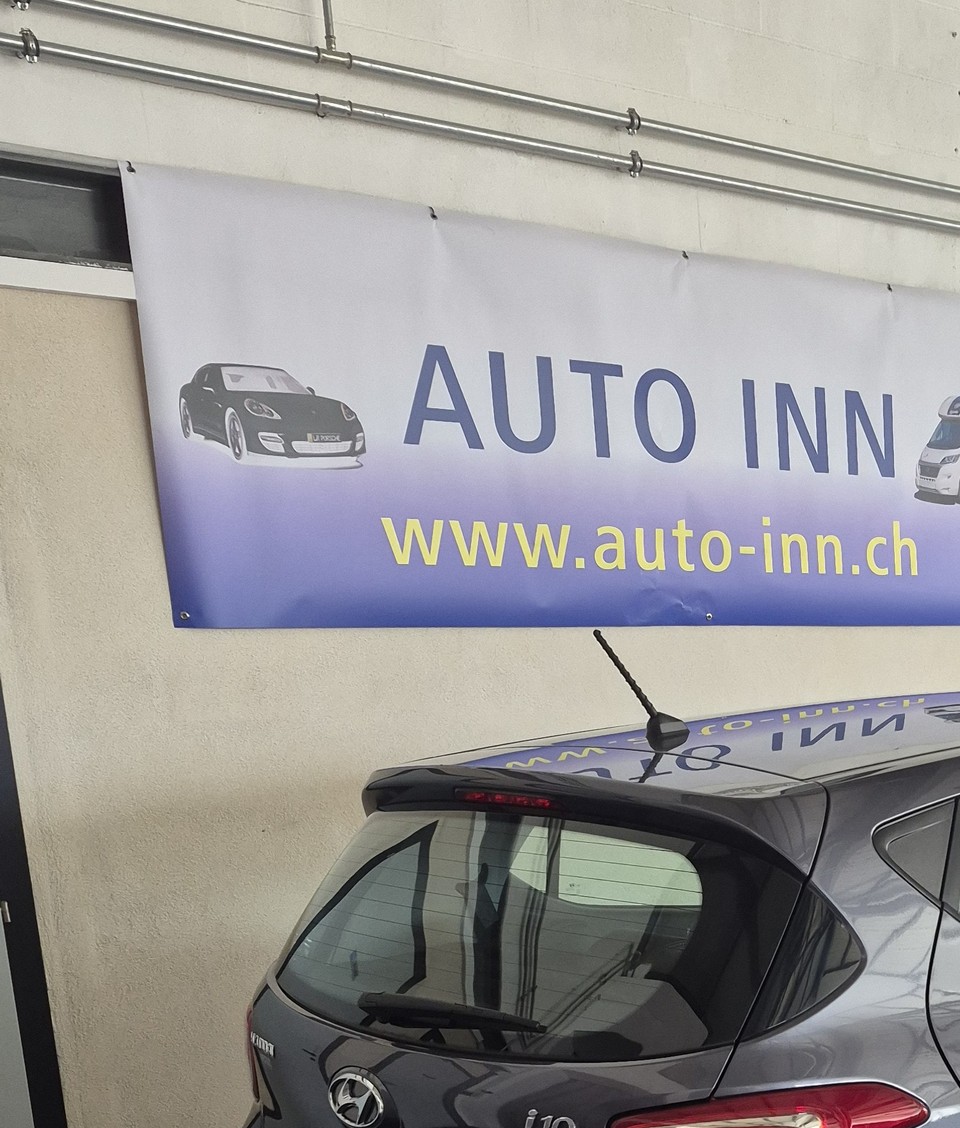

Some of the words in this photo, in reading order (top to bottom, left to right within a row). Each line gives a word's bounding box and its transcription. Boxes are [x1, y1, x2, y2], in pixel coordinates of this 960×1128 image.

[404, 344, 696, 464] AUTO
[742, 378, 895, 478] INN
[381, 517, 918, 577] www.auto-inn.ch
